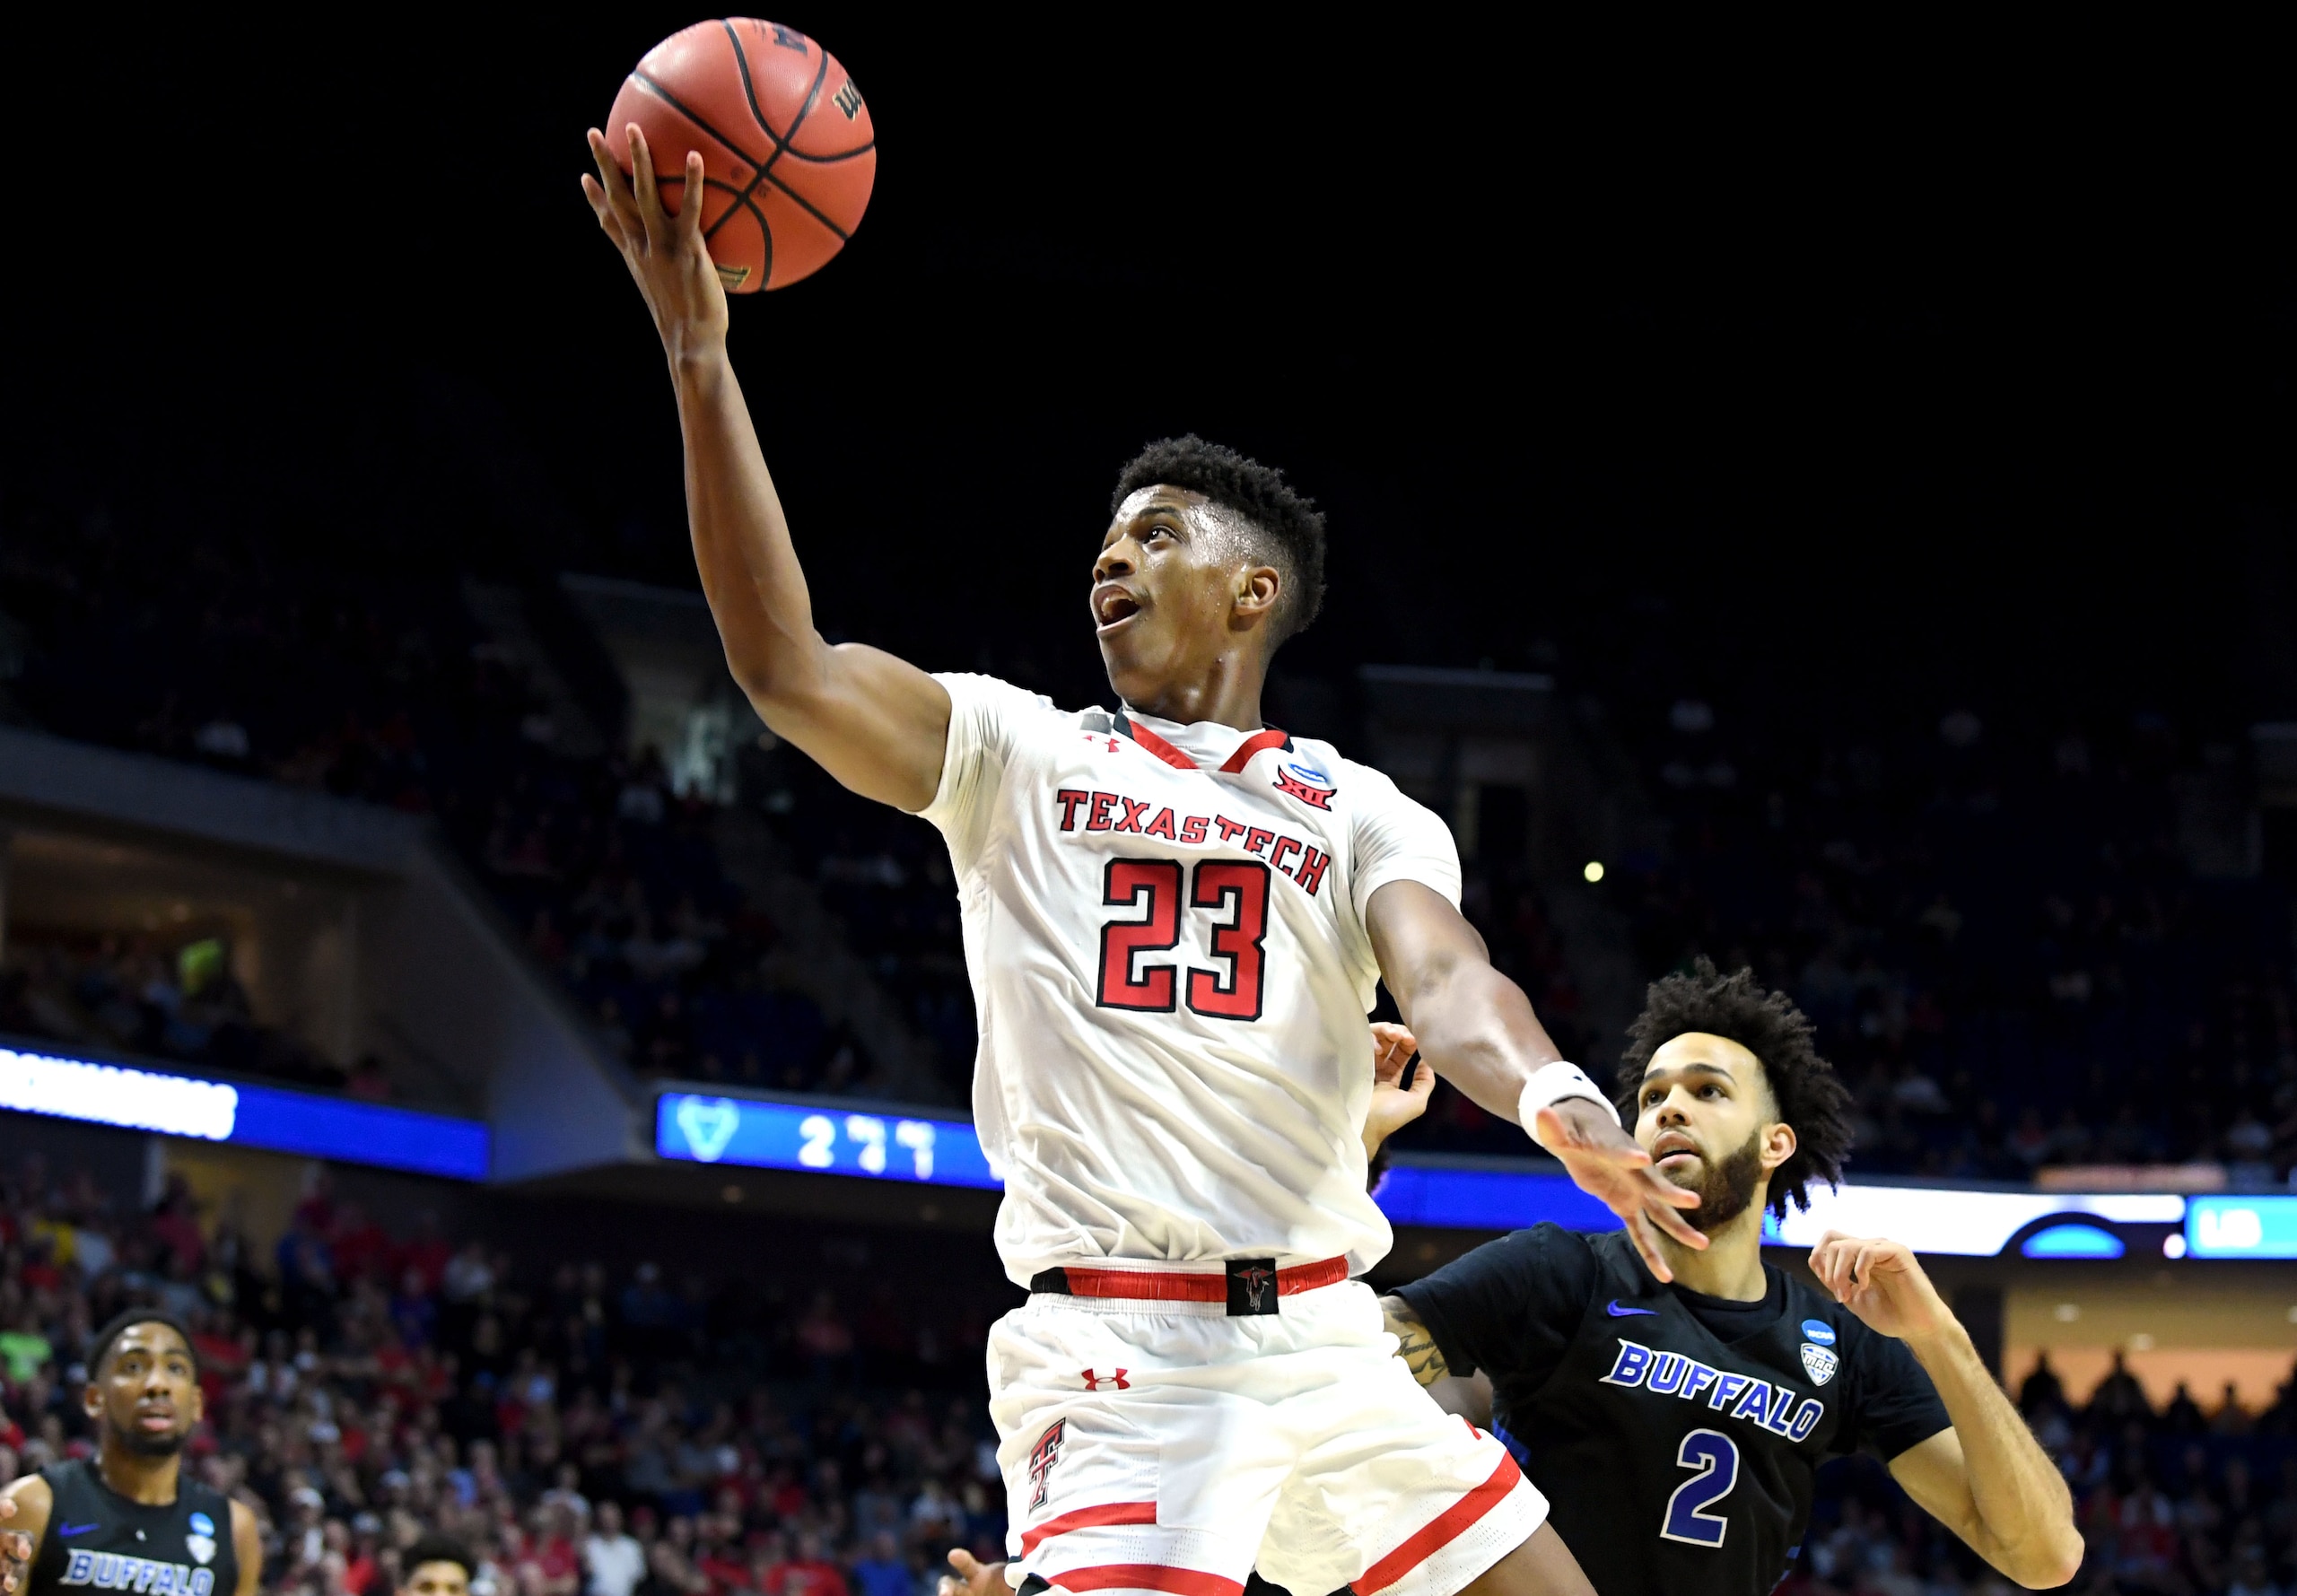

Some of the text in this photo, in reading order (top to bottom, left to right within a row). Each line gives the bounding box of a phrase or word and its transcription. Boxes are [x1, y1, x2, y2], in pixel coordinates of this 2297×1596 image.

[1056, 789, 1331, 897] TEXAS TECH
[1096, 857, 1272, 1022] 23
[1598, 1338, 1824, 1443] BUFFALO
[1660, 1428, 1740, 1548] 2
[58, 1548, 215, 1596] BUFFALO
